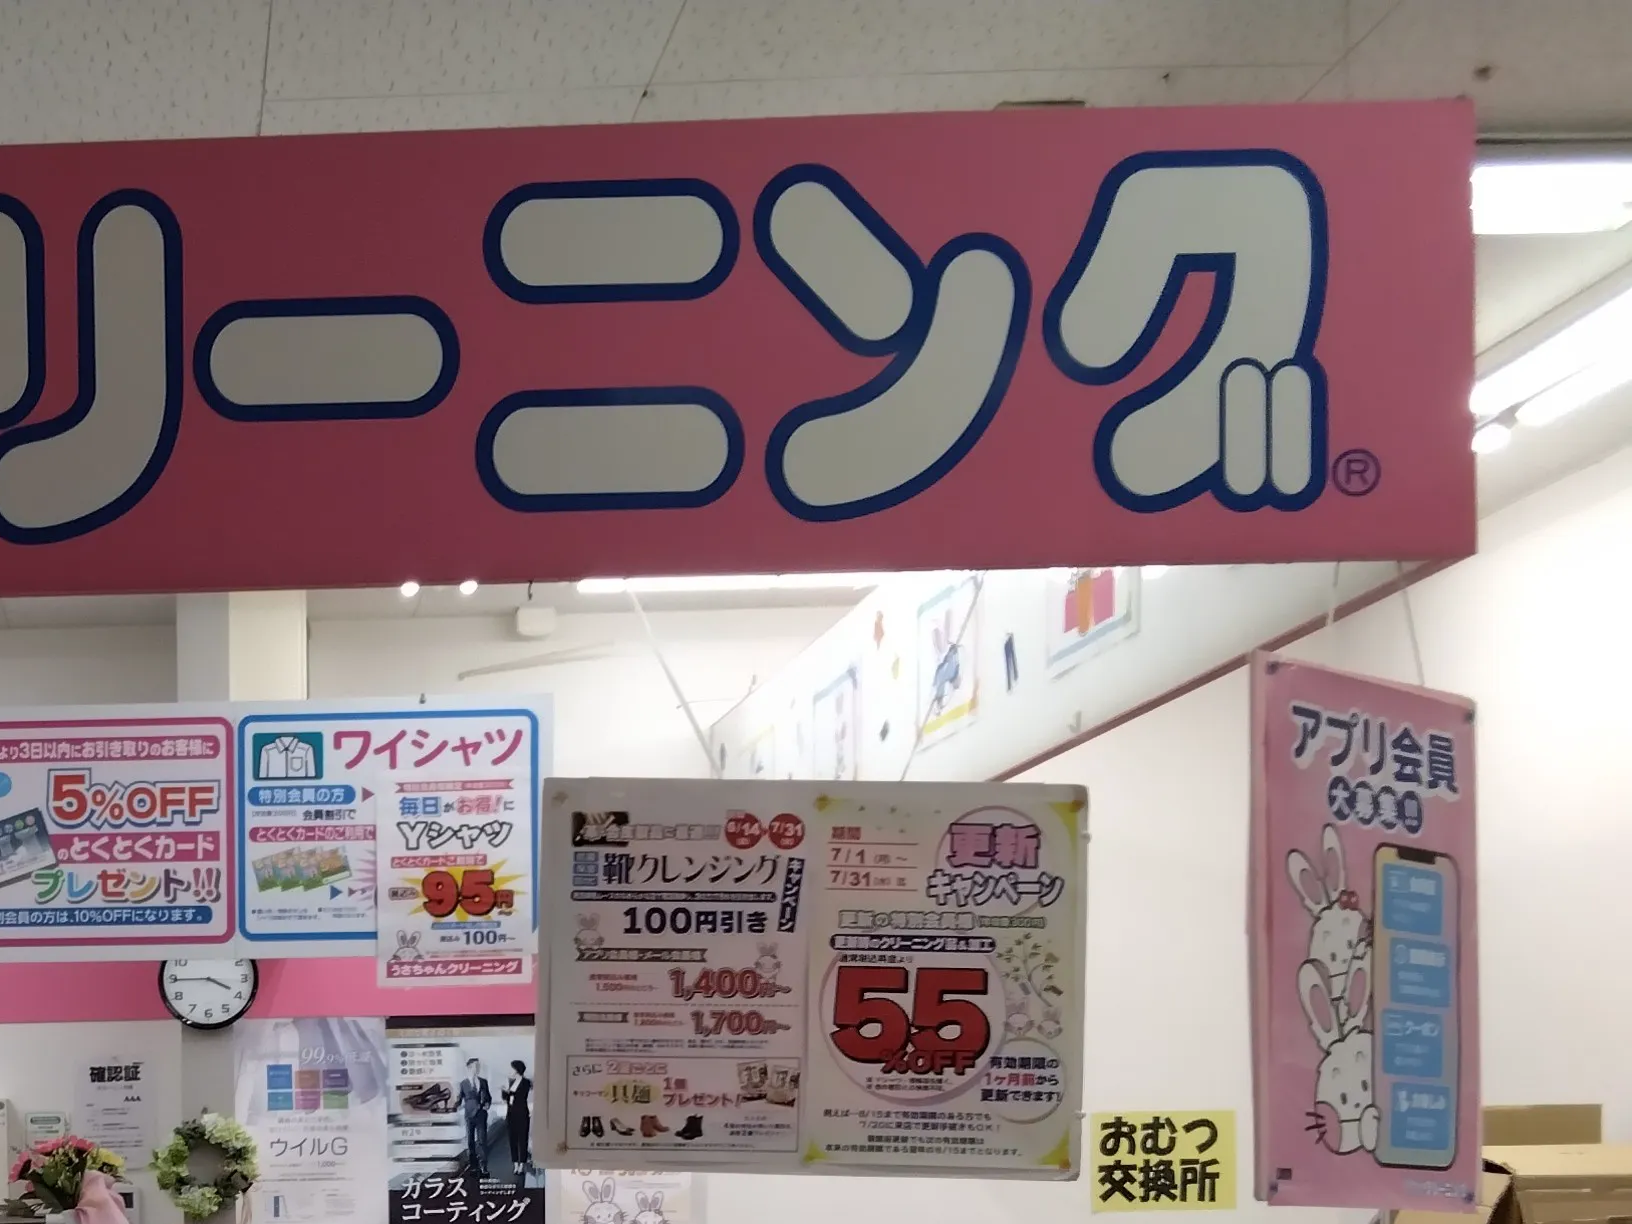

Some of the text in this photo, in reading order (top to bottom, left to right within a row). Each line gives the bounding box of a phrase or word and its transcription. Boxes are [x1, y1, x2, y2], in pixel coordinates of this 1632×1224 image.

[333, 729, 523, 769] ワイシャツ
[1292, 704, 1459, 794] アプリ会員
[51, 771, 216, 827] 5%OFF
[258, 788, 345, 804] 特別会員の方
[397, 820, 513, 850] Yシャツ
[946, 823, 1042, 868] 更新
[602, 853, 782, 885] 靴クレンジング
[32, 868, 221, 904] プレゼント!!
[926, 869, 1065, 907] キャンペーン
[623, 906, 768, 934] 100円引き
[240, 974, 249, 983] 3
[391, 960, 518, 977] うさちゃんクリーニング
[174, 991, 184, 1001] 8
[188, 1004, 198, 1014] 7
[221, 1004, 231, 1014] 5
[234, 991, 244, 1000] 4
[204, 1008, 214, 1019] 6
[829, 965, 991, 1064] 55
[89, 1064, 142, 1083] 確認証
[269, 1136, 348, 1157] ウイルG
[1099, 1116, 1218, 1157] おむつ
[400, 1177, 468, 1200] ガラス
[1098, 1159, 1220, 1203] 交換所
[402, 1196, 531, 1223] コーティング
